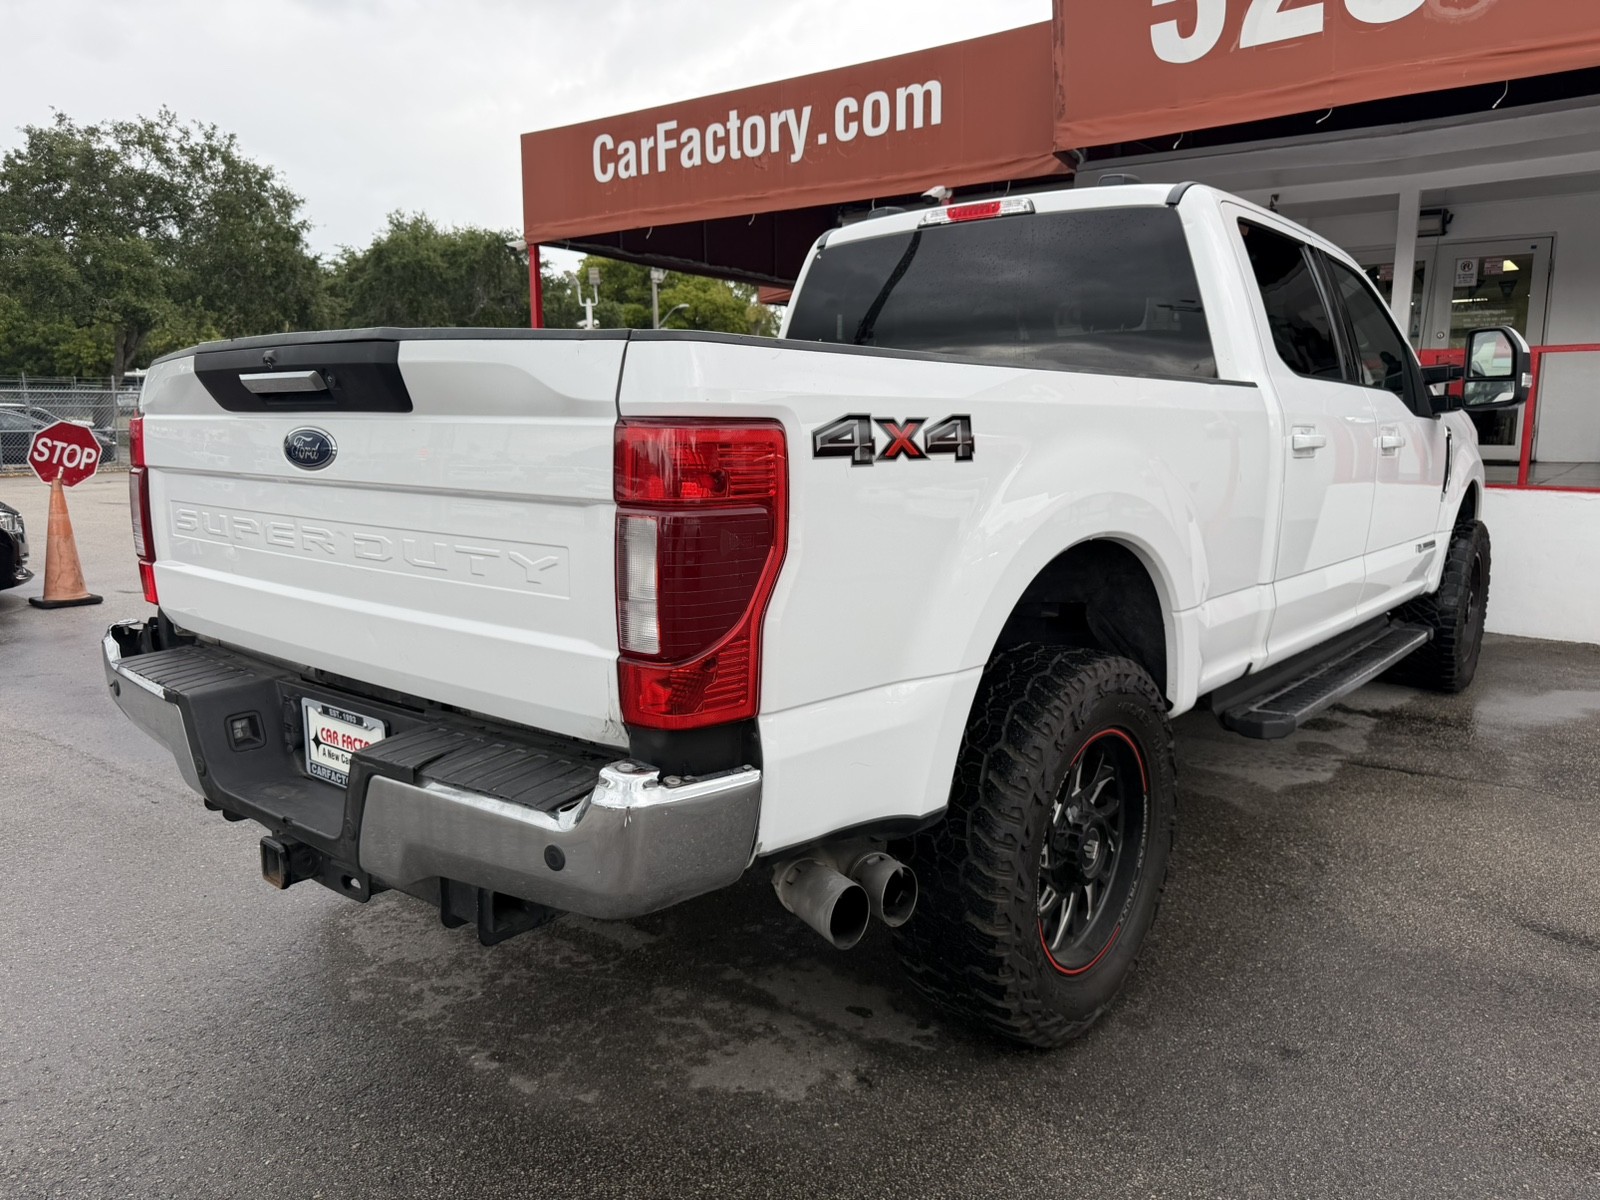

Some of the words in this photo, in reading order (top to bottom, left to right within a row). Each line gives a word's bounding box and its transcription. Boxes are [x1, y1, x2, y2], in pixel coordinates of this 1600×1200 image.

[593, 80, 942, 183] CarFactory.com
[33, 437, 97, 470] STOP
[291, 435, 320, 460] Ford
[175, 507, 336, 555] SUPER
[353, 531, 561, 585] DUTY
[328, 708, 342, 719] EST.
[320, 727, 339, 746] CAR
[322, 747, 327, 757] A
[327, 748, 340, 762] New
